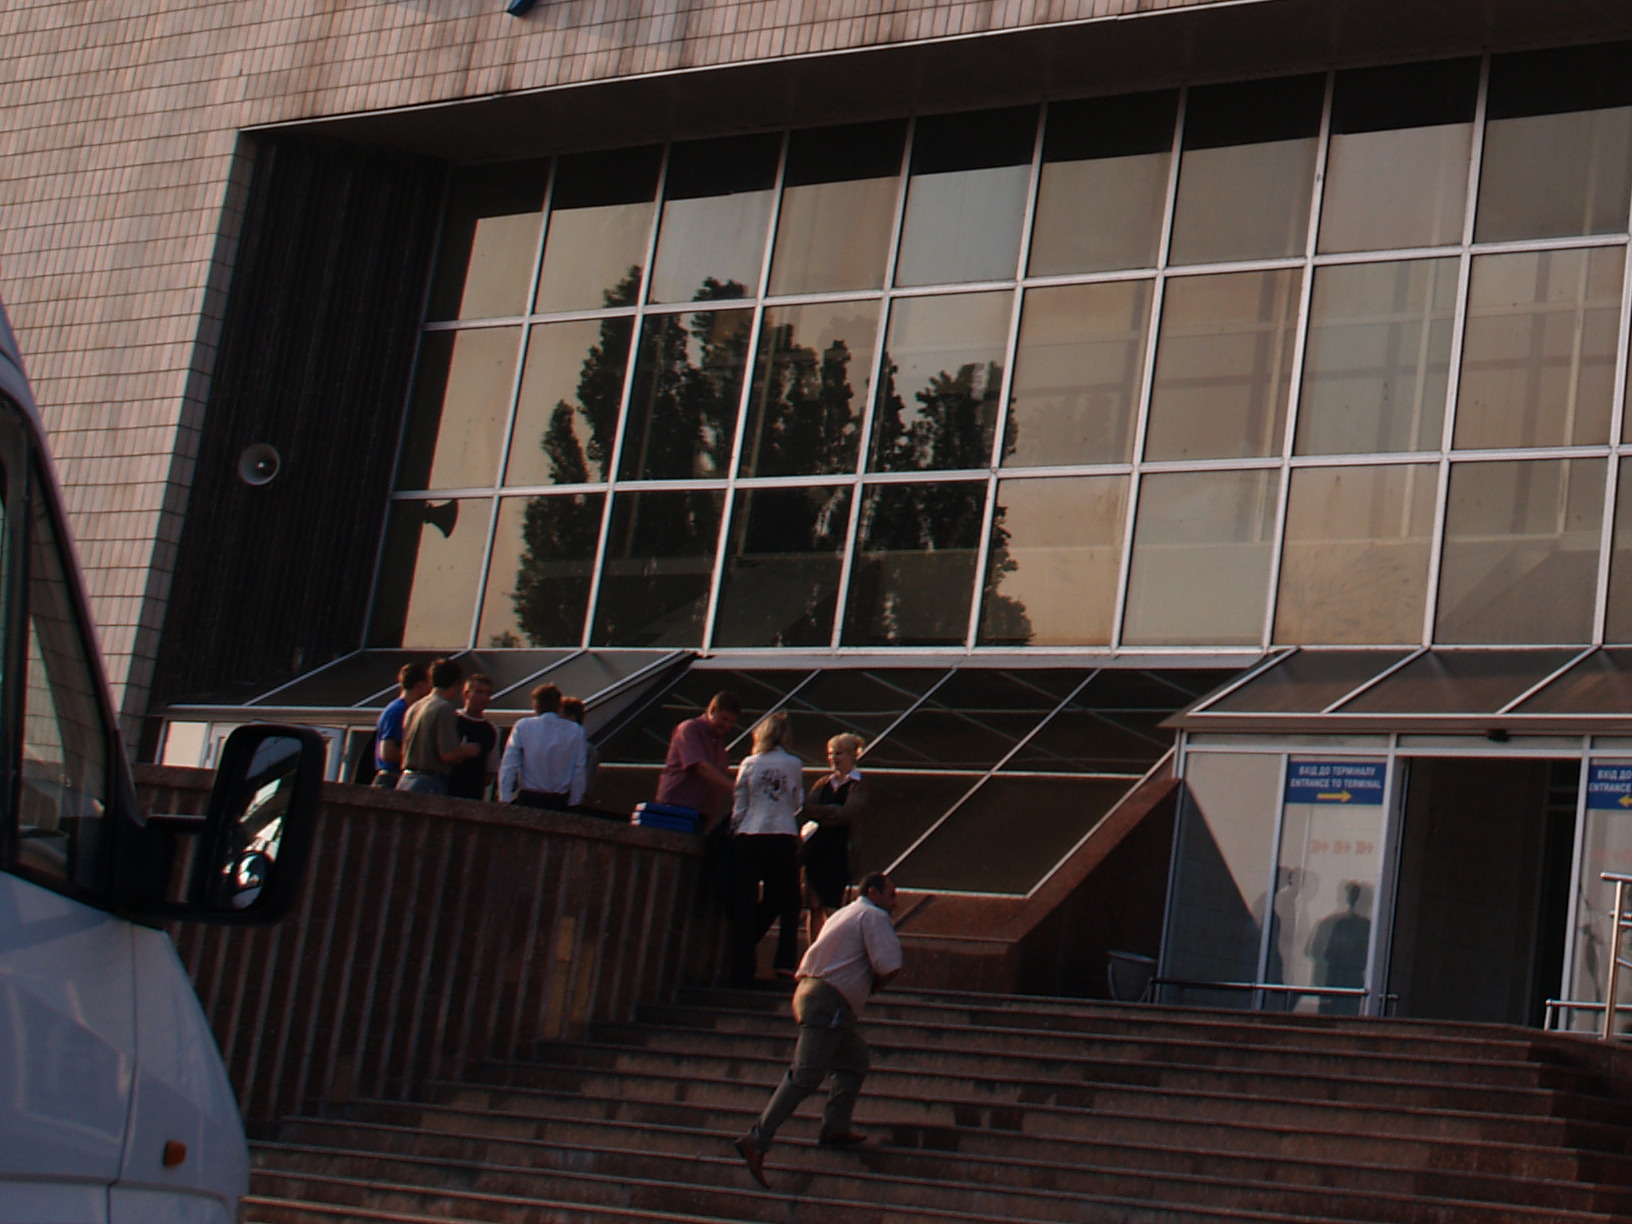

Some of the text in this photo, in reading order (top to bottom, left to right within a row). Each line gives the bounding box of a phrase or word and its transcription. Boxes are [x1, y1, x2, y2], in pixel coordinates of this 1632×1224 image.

[1619, 769, 1632, 781] ДО
[1331, 778, 1342, 788] TO
[1588, 782, 1632, 793] ENTRANCE
